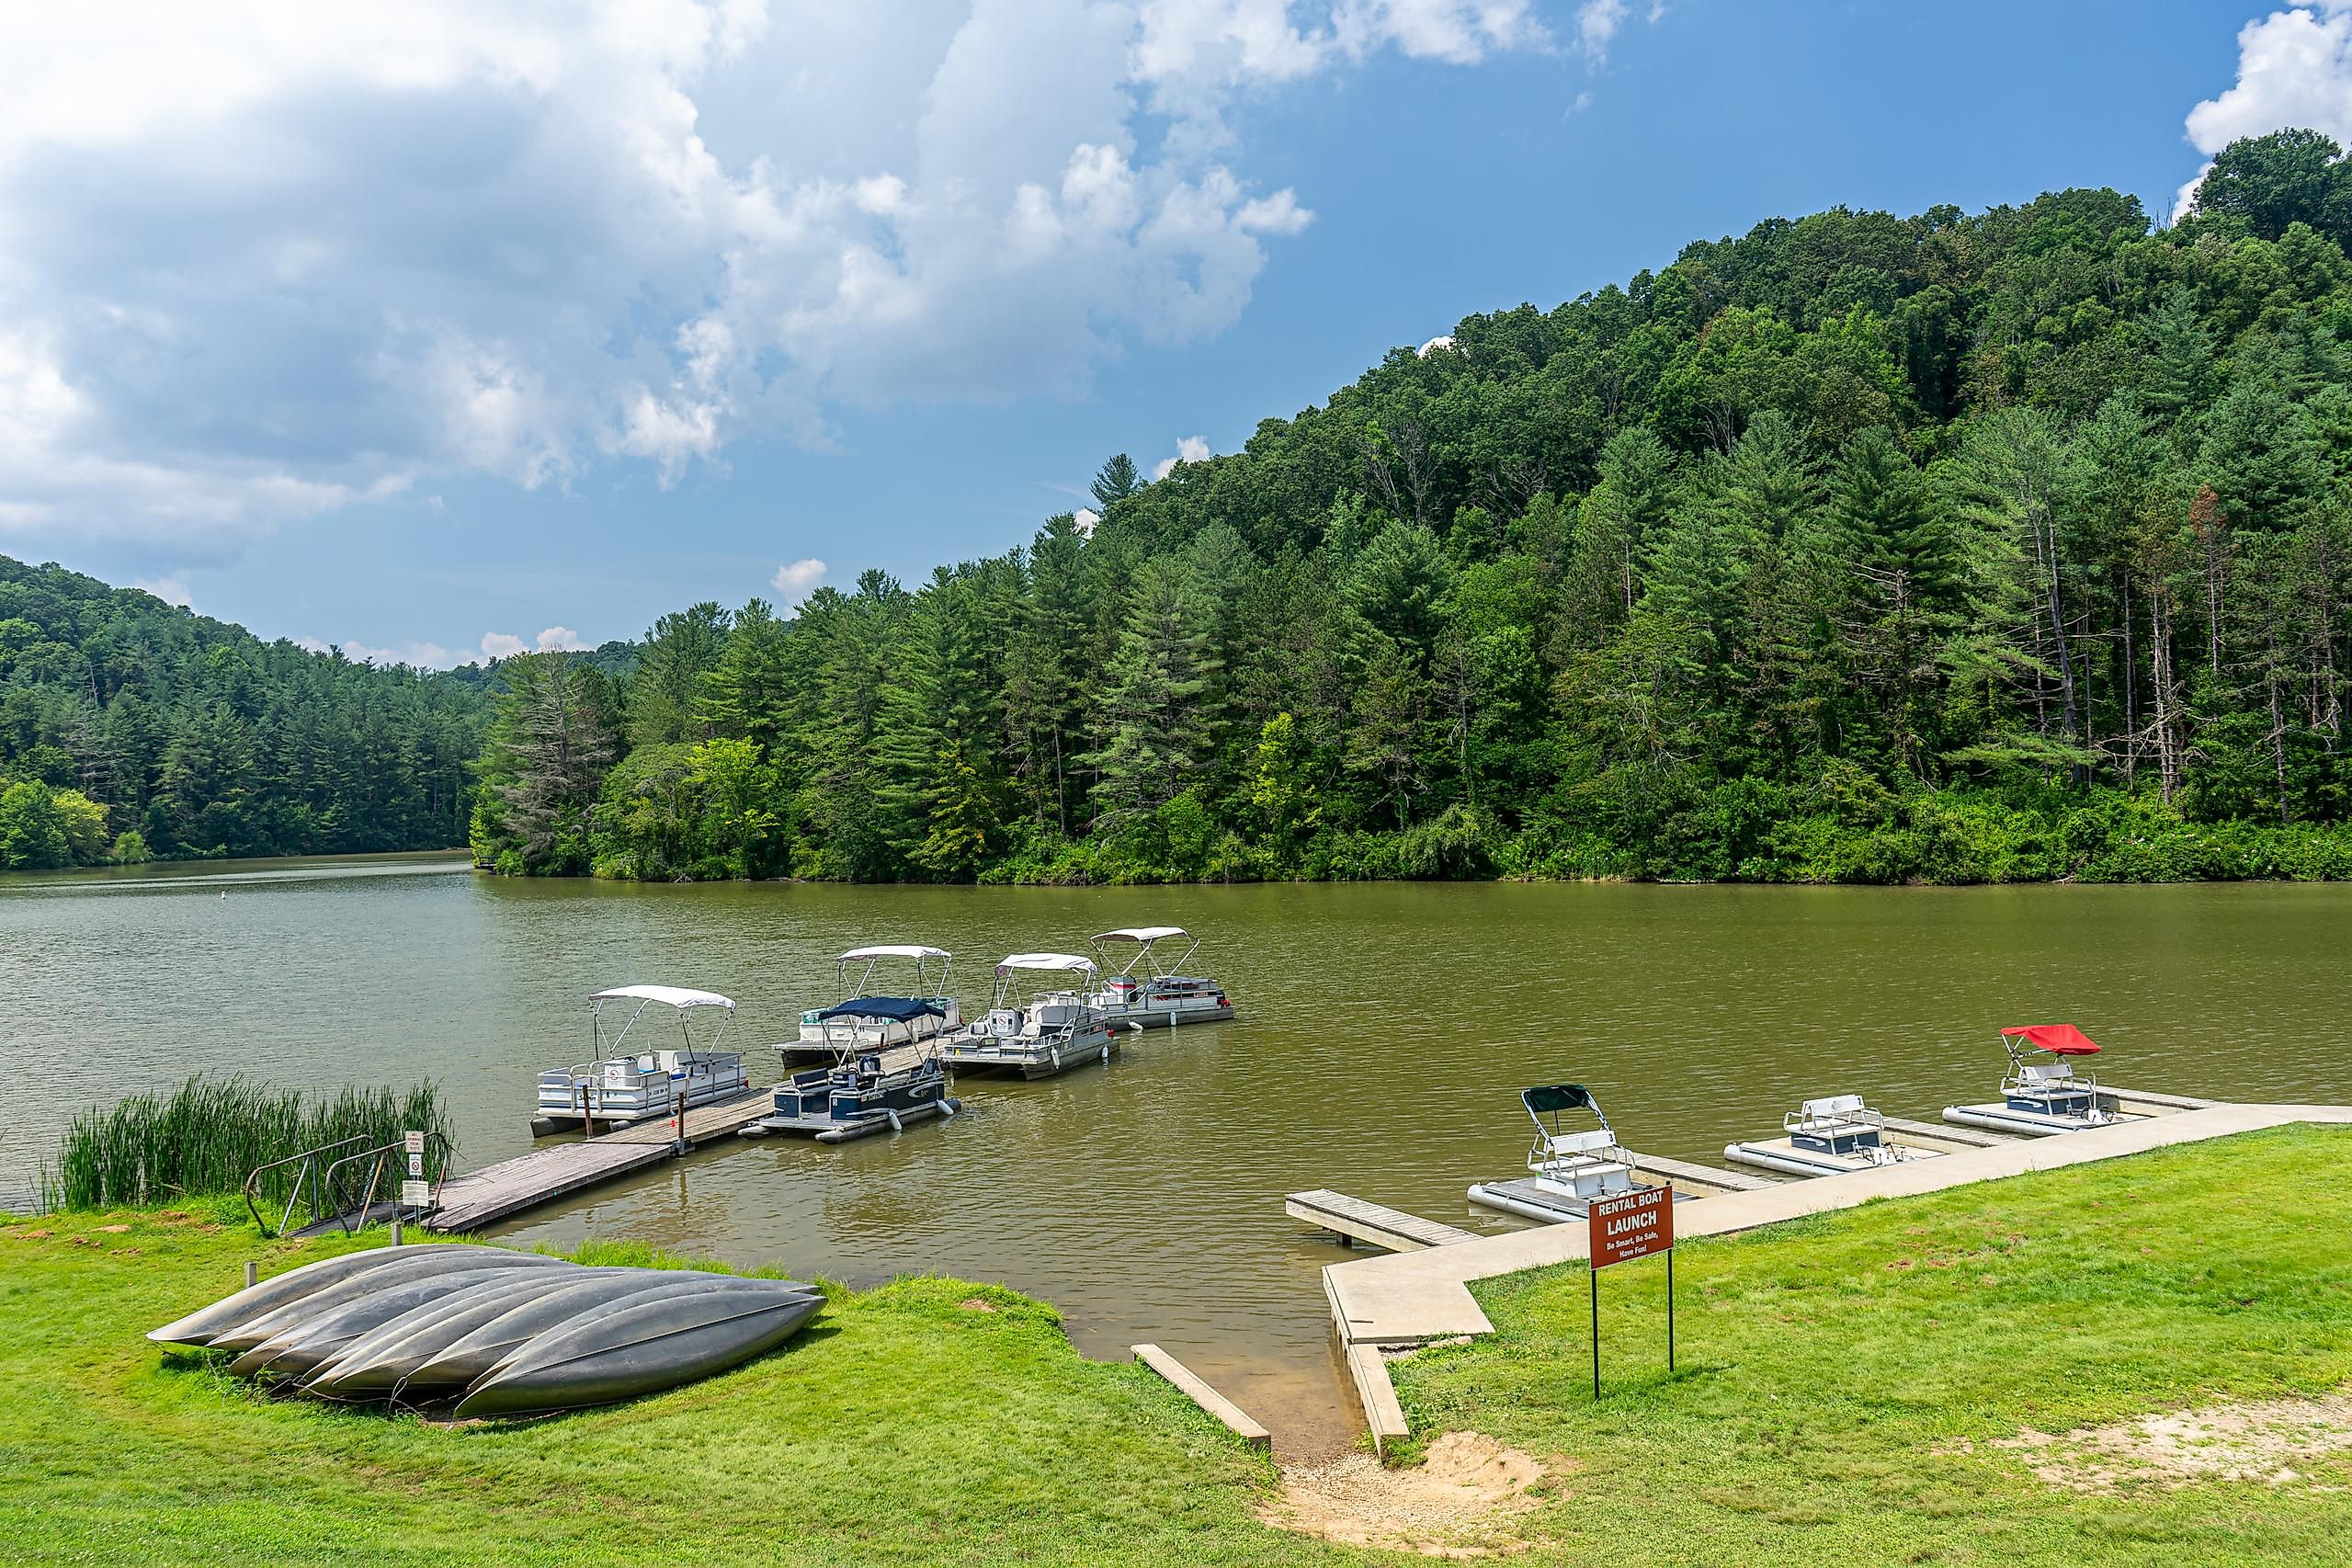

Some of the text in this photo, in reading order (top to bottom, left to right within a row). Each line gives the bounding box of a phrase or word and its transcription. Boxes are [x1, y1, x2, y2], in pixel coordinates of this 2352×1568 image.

[1608, 1133, 1614, 1142] 3
[1598, 1190, 1664, 1217] RENTAL BOAT
[1607, 1210, 1657, 1236] LAUNCH
[1607, 1231, 1659, 1251] Be Smart, Be Safe,
[1619, 1249, 1634, 1258] Have
